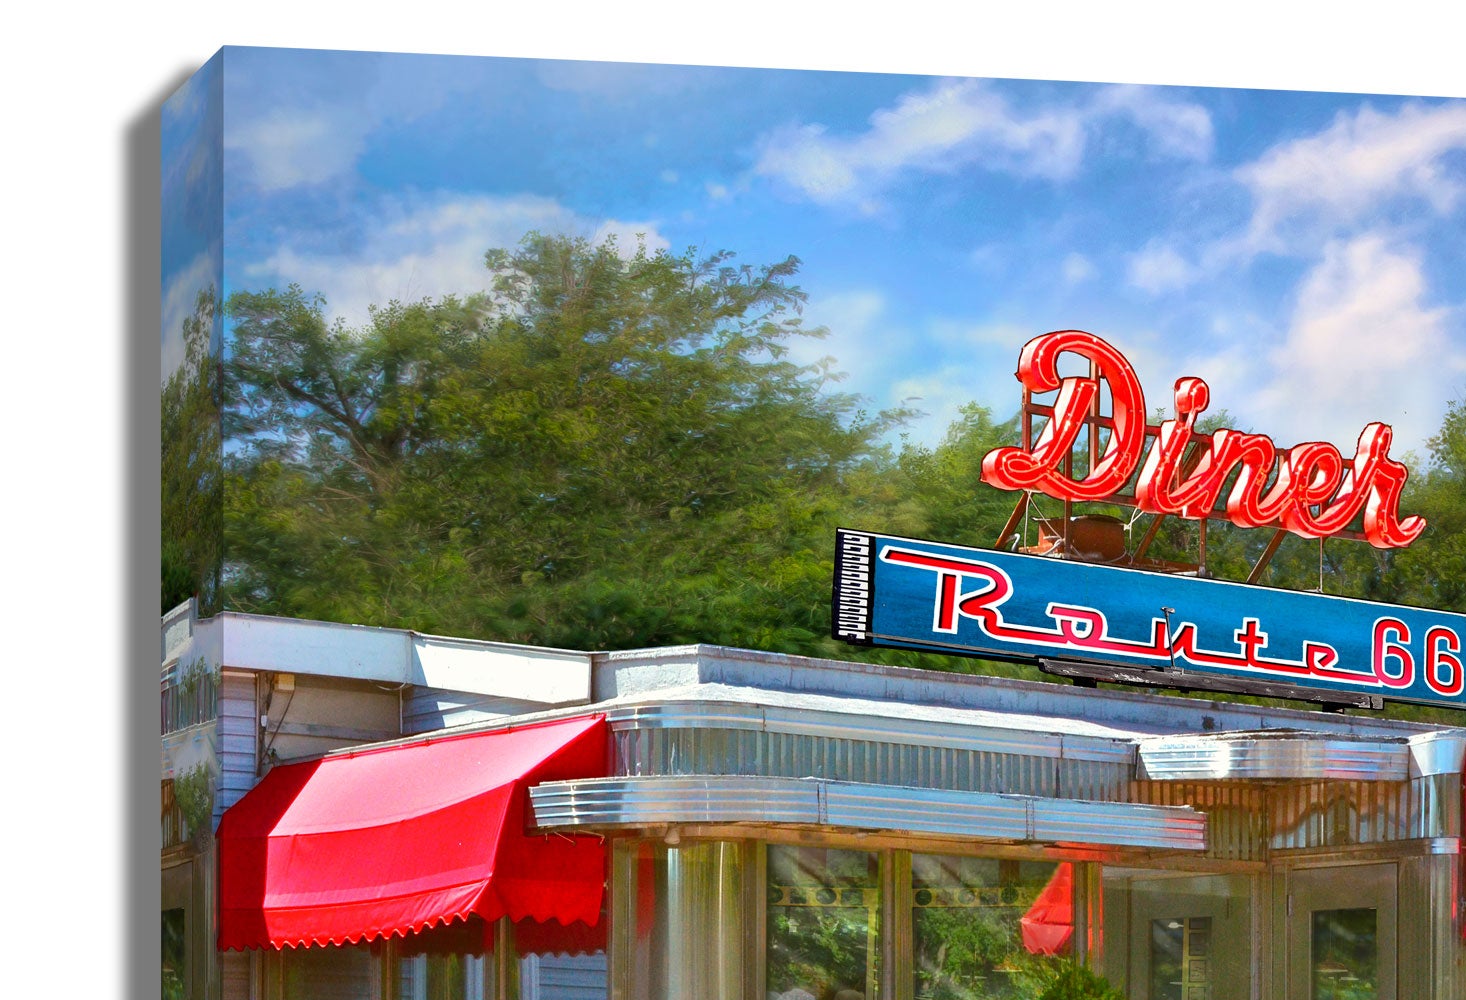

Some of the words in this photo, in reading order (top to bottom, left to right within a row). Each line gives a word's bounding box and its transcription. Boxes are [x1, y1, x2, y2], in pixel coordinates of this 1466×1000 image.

[981, 330, 1427, 549] Diner
[880, 544, 1380, 688] Route
[1371, 618, 1465, 696] 66
